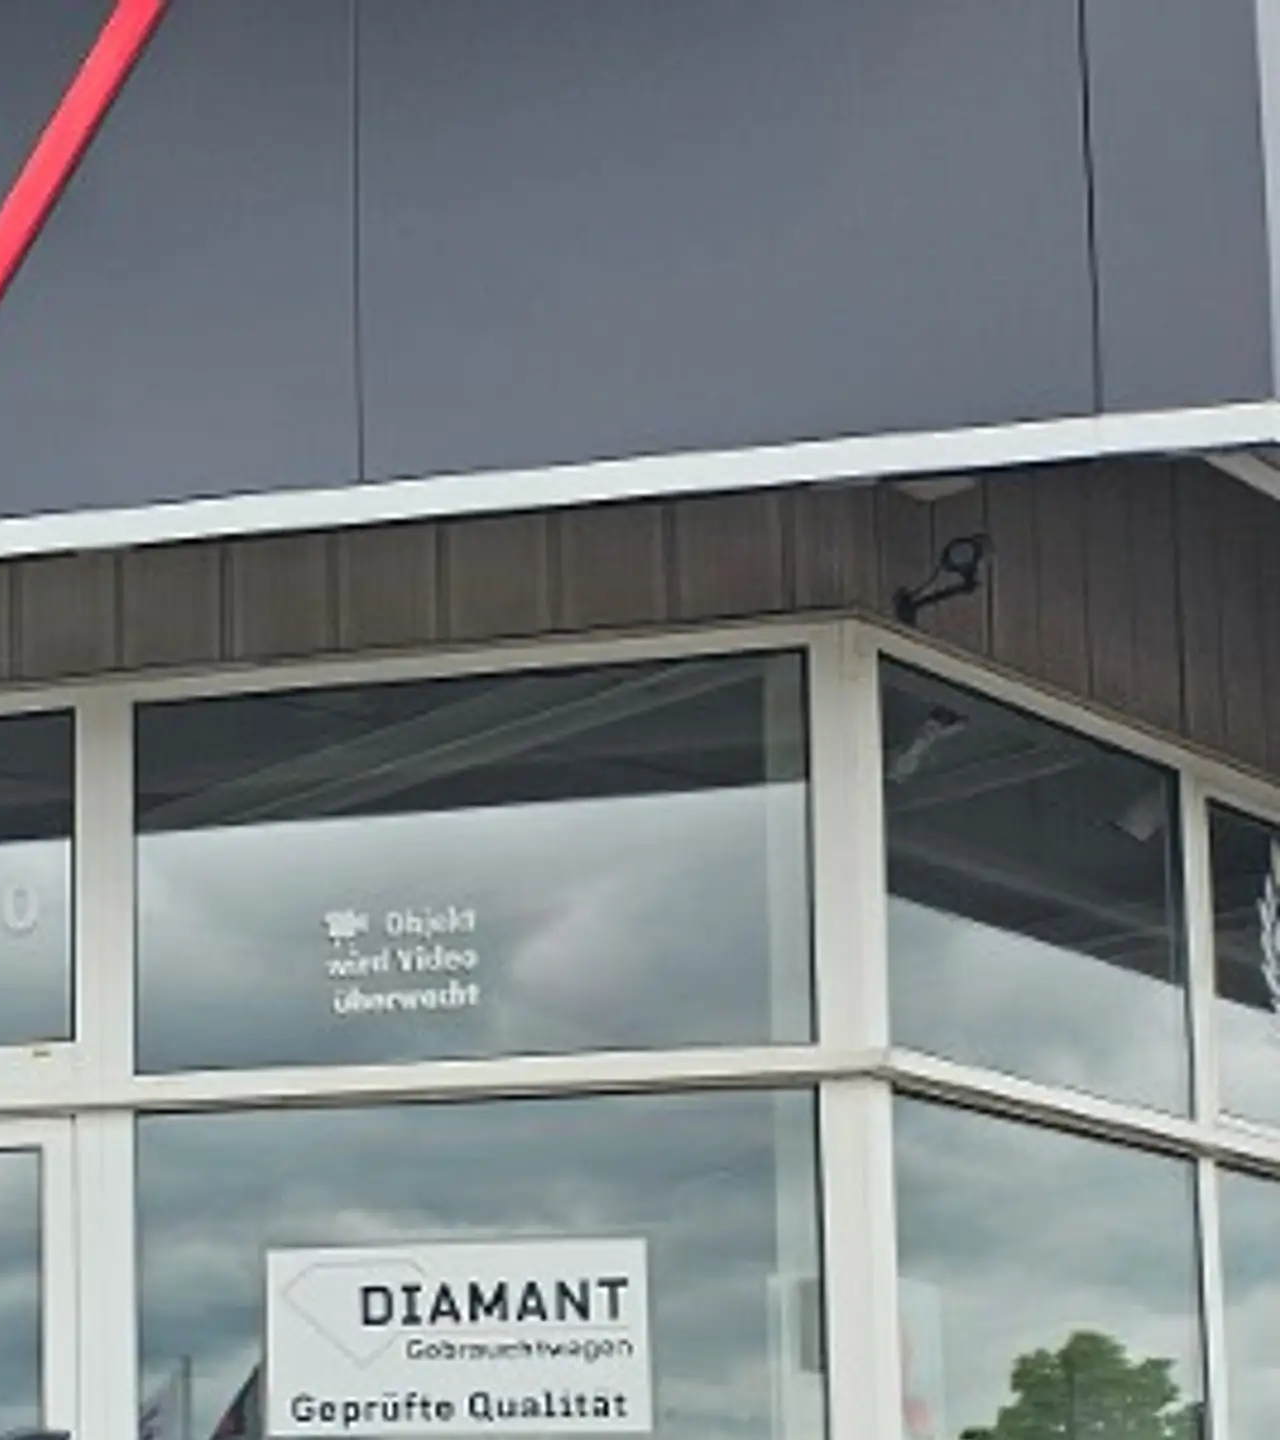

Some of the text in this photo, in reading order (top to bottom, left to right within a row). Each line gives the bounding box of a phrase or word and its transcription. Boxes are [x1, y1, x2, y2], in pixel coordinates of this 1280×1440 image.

[395, 944, 480, 973] Video
[360, 1277, 629, 1326] DIAMANT
[406, 1337, 634, 1364] Gebrauchtwagen
[291, 1389, 629, 1429] Geprüfte Qualität
